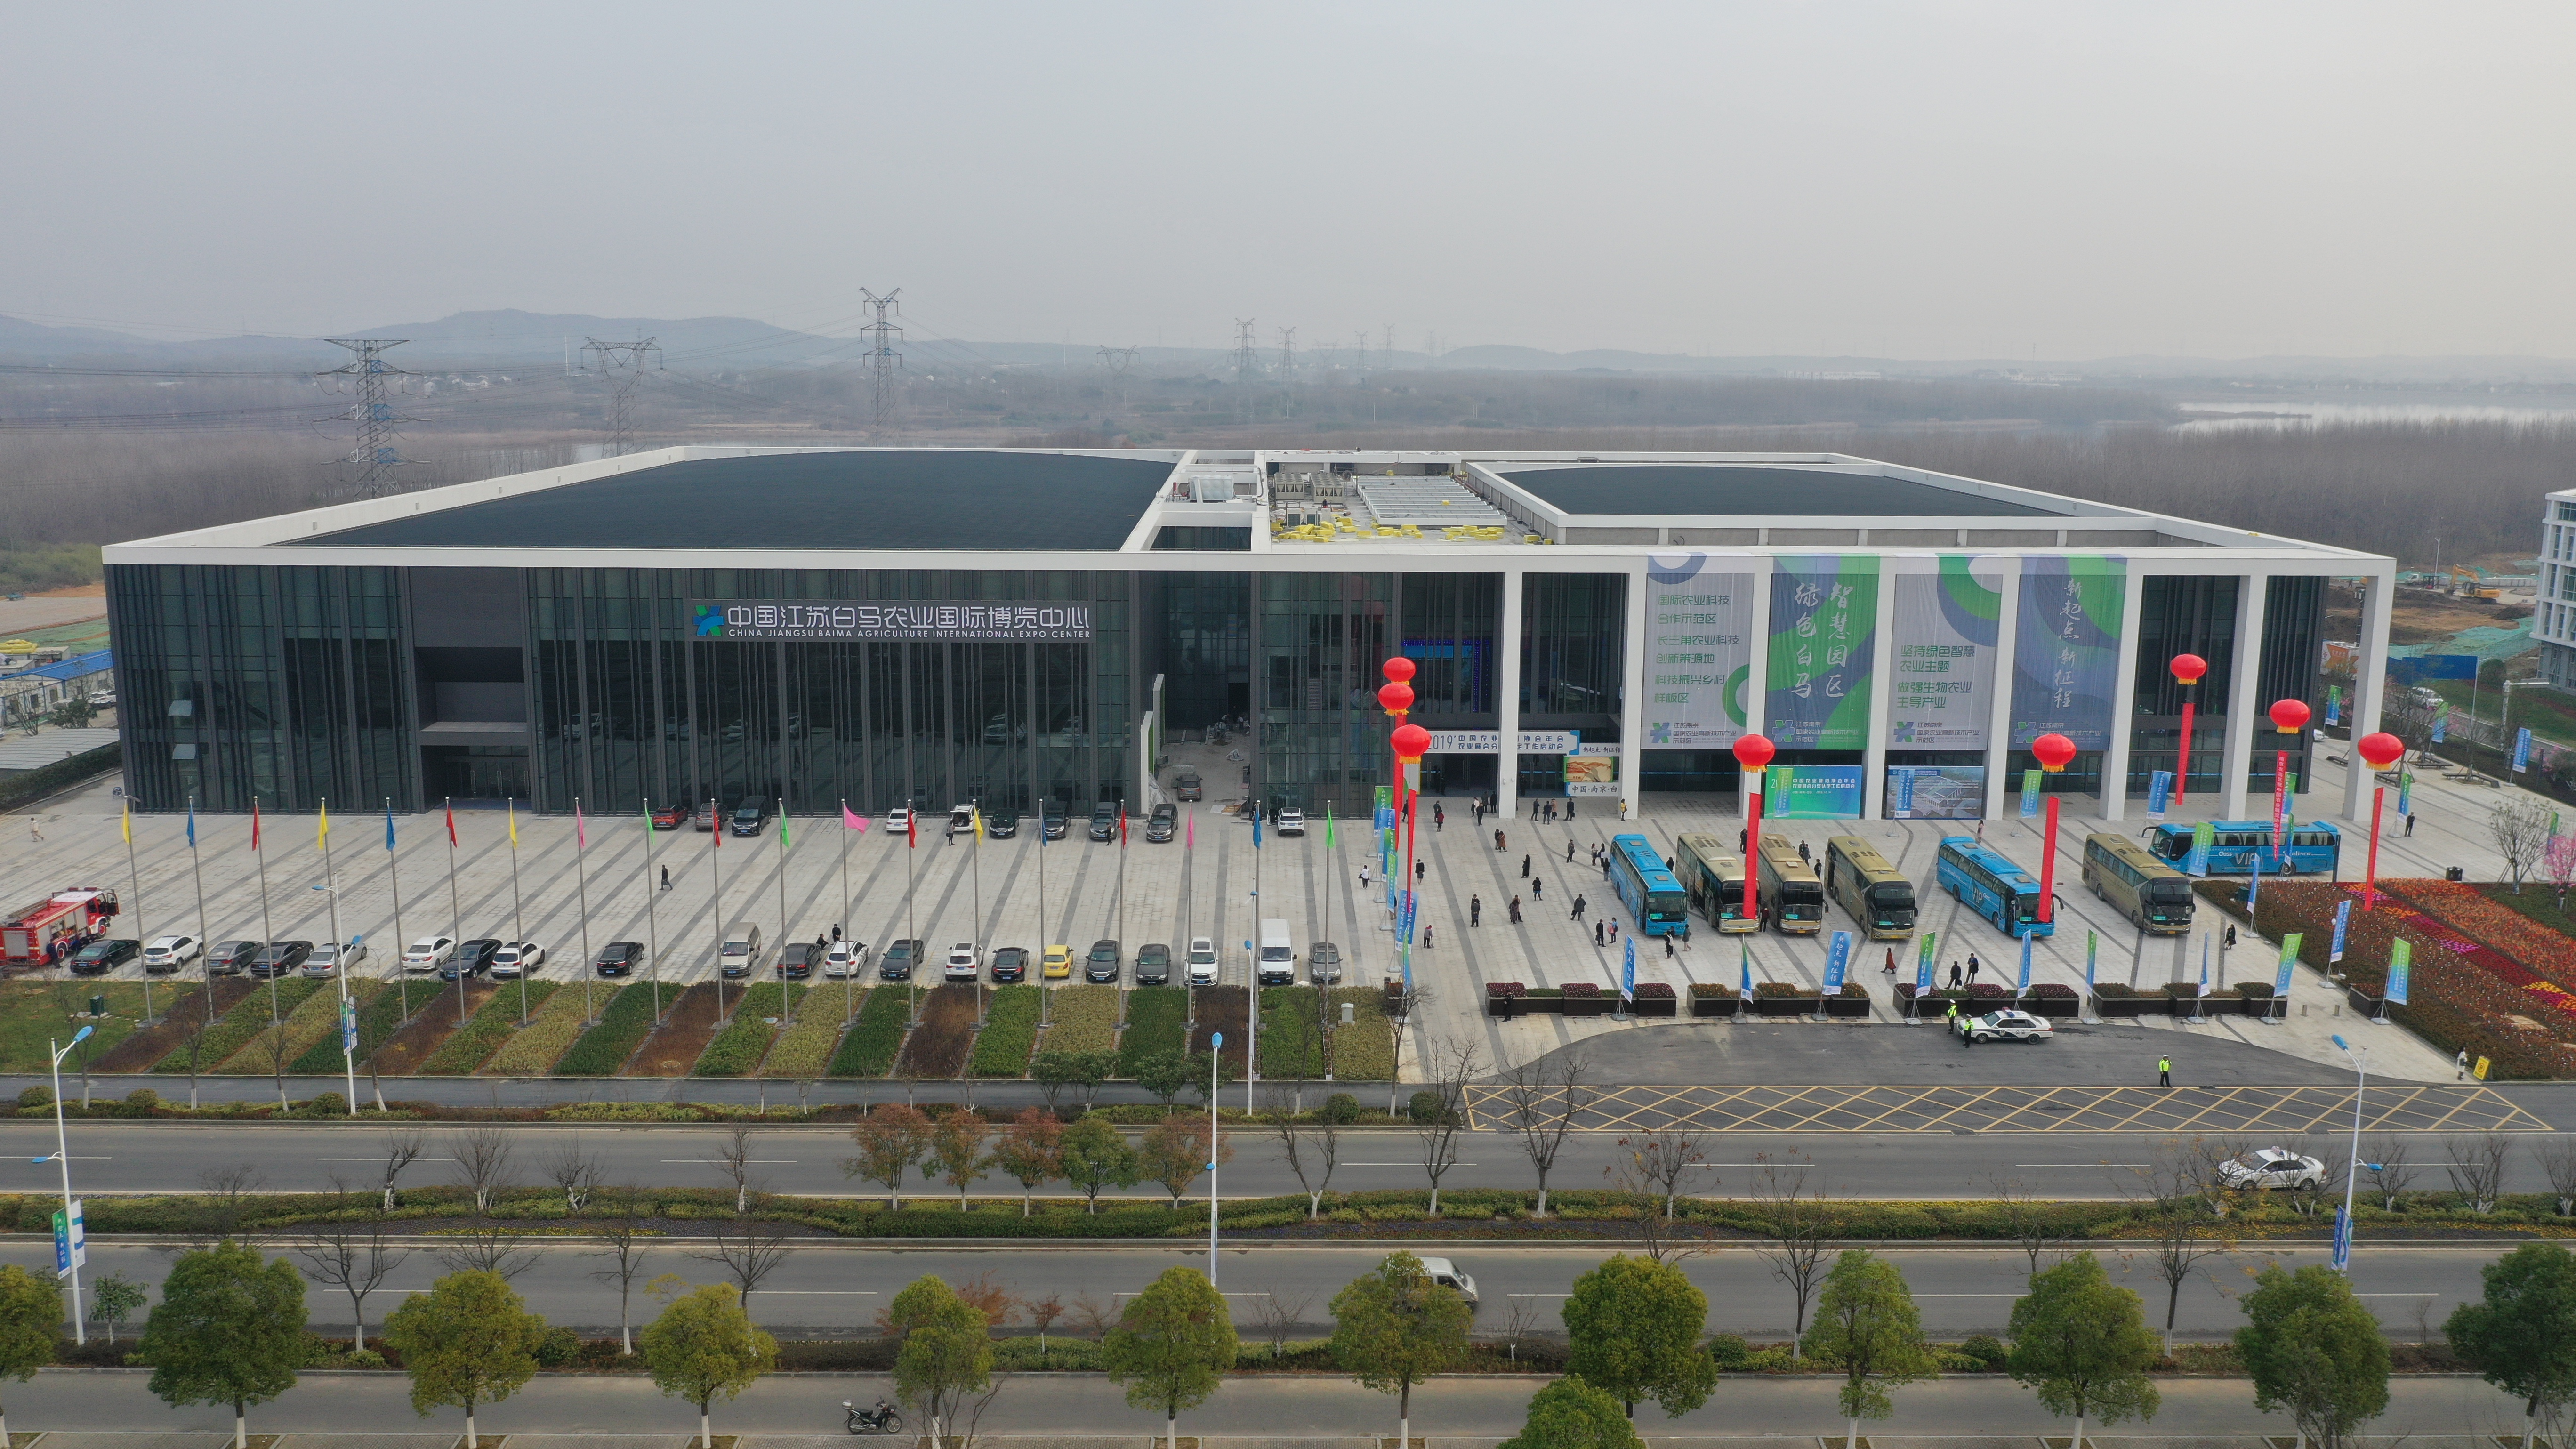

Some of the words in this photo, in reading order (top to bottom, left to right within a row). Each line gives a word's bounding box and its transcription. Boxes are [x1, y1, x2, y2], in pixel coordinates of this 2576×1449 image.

[1658, 595, 1729, 605] 国际农业科技
[728, 605, 1089, 628] 中国江苏白马农业国际博览中心
[1658, 614, 1716, 624] 合作示范区
[1657, 635, 1739, 645] 长三角农业科技
[1791, 583, 1821, 698] 绿色白马
[1826, 582, 1853, 697] 智慧园区
[1900, 645, 1975, 657] 坚持绿色智慧
[1656, 653, 1715, 664] 创新策源地
[1900, 660, 1950, 672] 农业主题
[1655, 674, 1725, 685] 科技振兴乡村
[1897, 681, 1972, 693] 做强生物农业
[1654, 692, 1689, 703] 样板区
[1897, 696, 1947, 708] 主导产业
[1428, 735, 1456, 749] 019'
